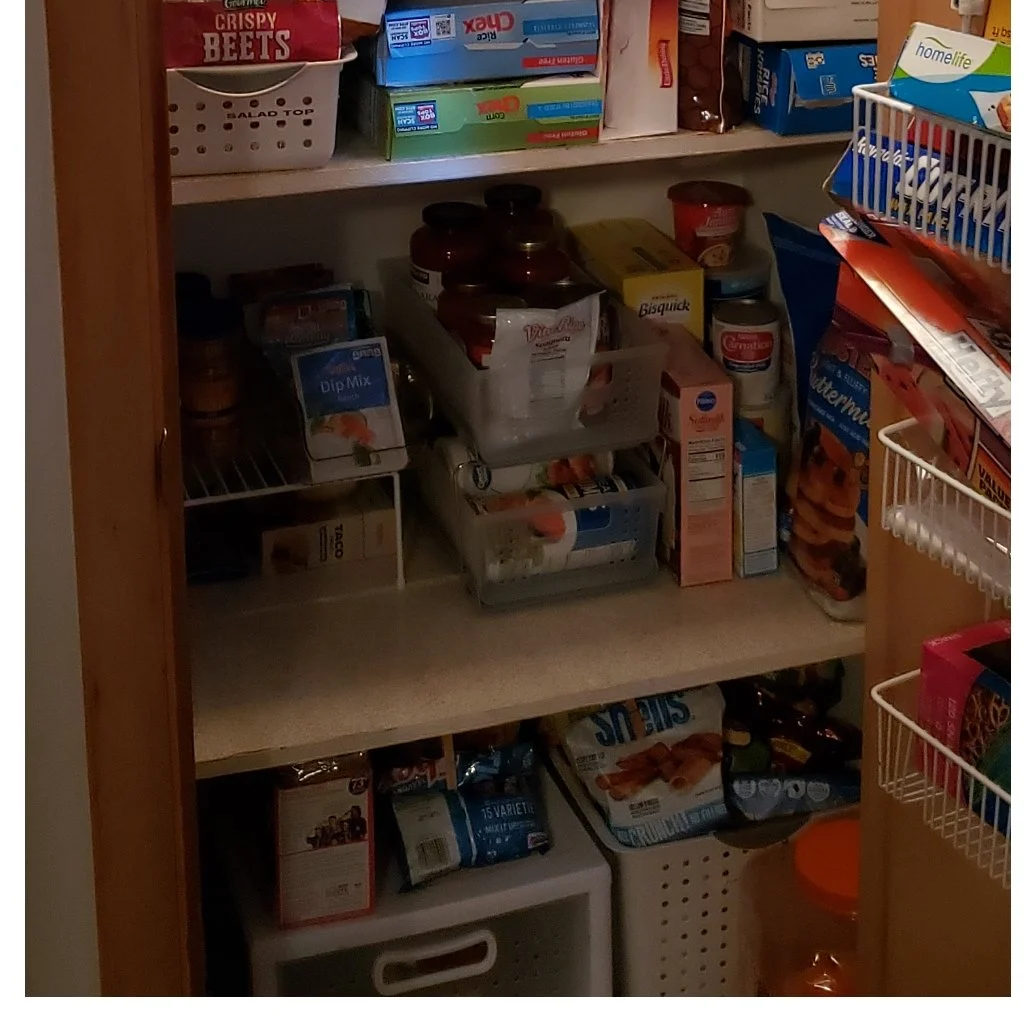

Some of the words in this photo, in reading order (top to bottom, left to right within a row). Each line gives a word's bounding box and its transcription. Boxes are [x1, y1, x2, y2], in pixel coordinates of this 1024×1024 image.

[215, 11, 278, 32] CRISPY
[463, 10, 515, 34] Chex
[202, 29, 292, 63] BEETS
[476, 30, 498, 42] Rice
[914, 40, 974, 71] homelife
[227, 108, 279, 120] SALAD
[282, 107, 315, 117] TOP
[485, 111, 506, 122] Corn
[638, 300, 690, 319] Bisquick
[320, 376, 346, 395] Dip
[346, 374, 373, 390] Mix
